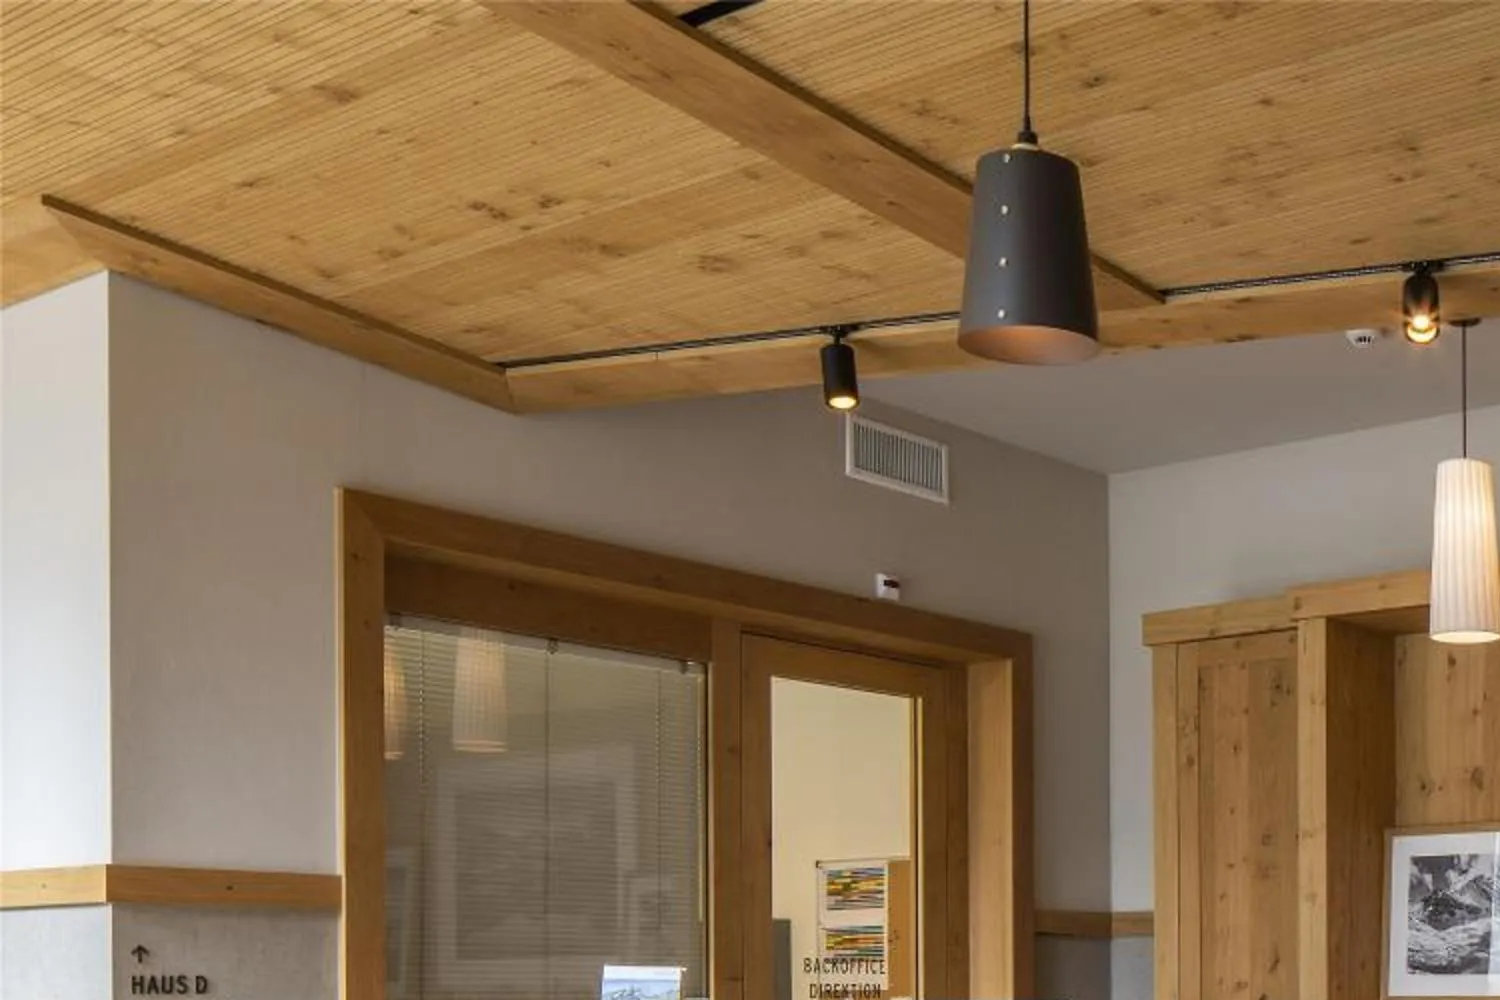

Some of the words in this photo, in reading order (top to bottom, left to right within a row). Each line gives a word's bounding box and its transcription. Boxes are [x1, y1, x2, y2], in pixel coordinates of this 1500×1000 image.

[803, 957, 886, 975] BACKOFFICE
[131, 975, 188, 995] HAUS
[195, 975, 209, 994] D
[809, 983, 882, 999] DIREKTION
